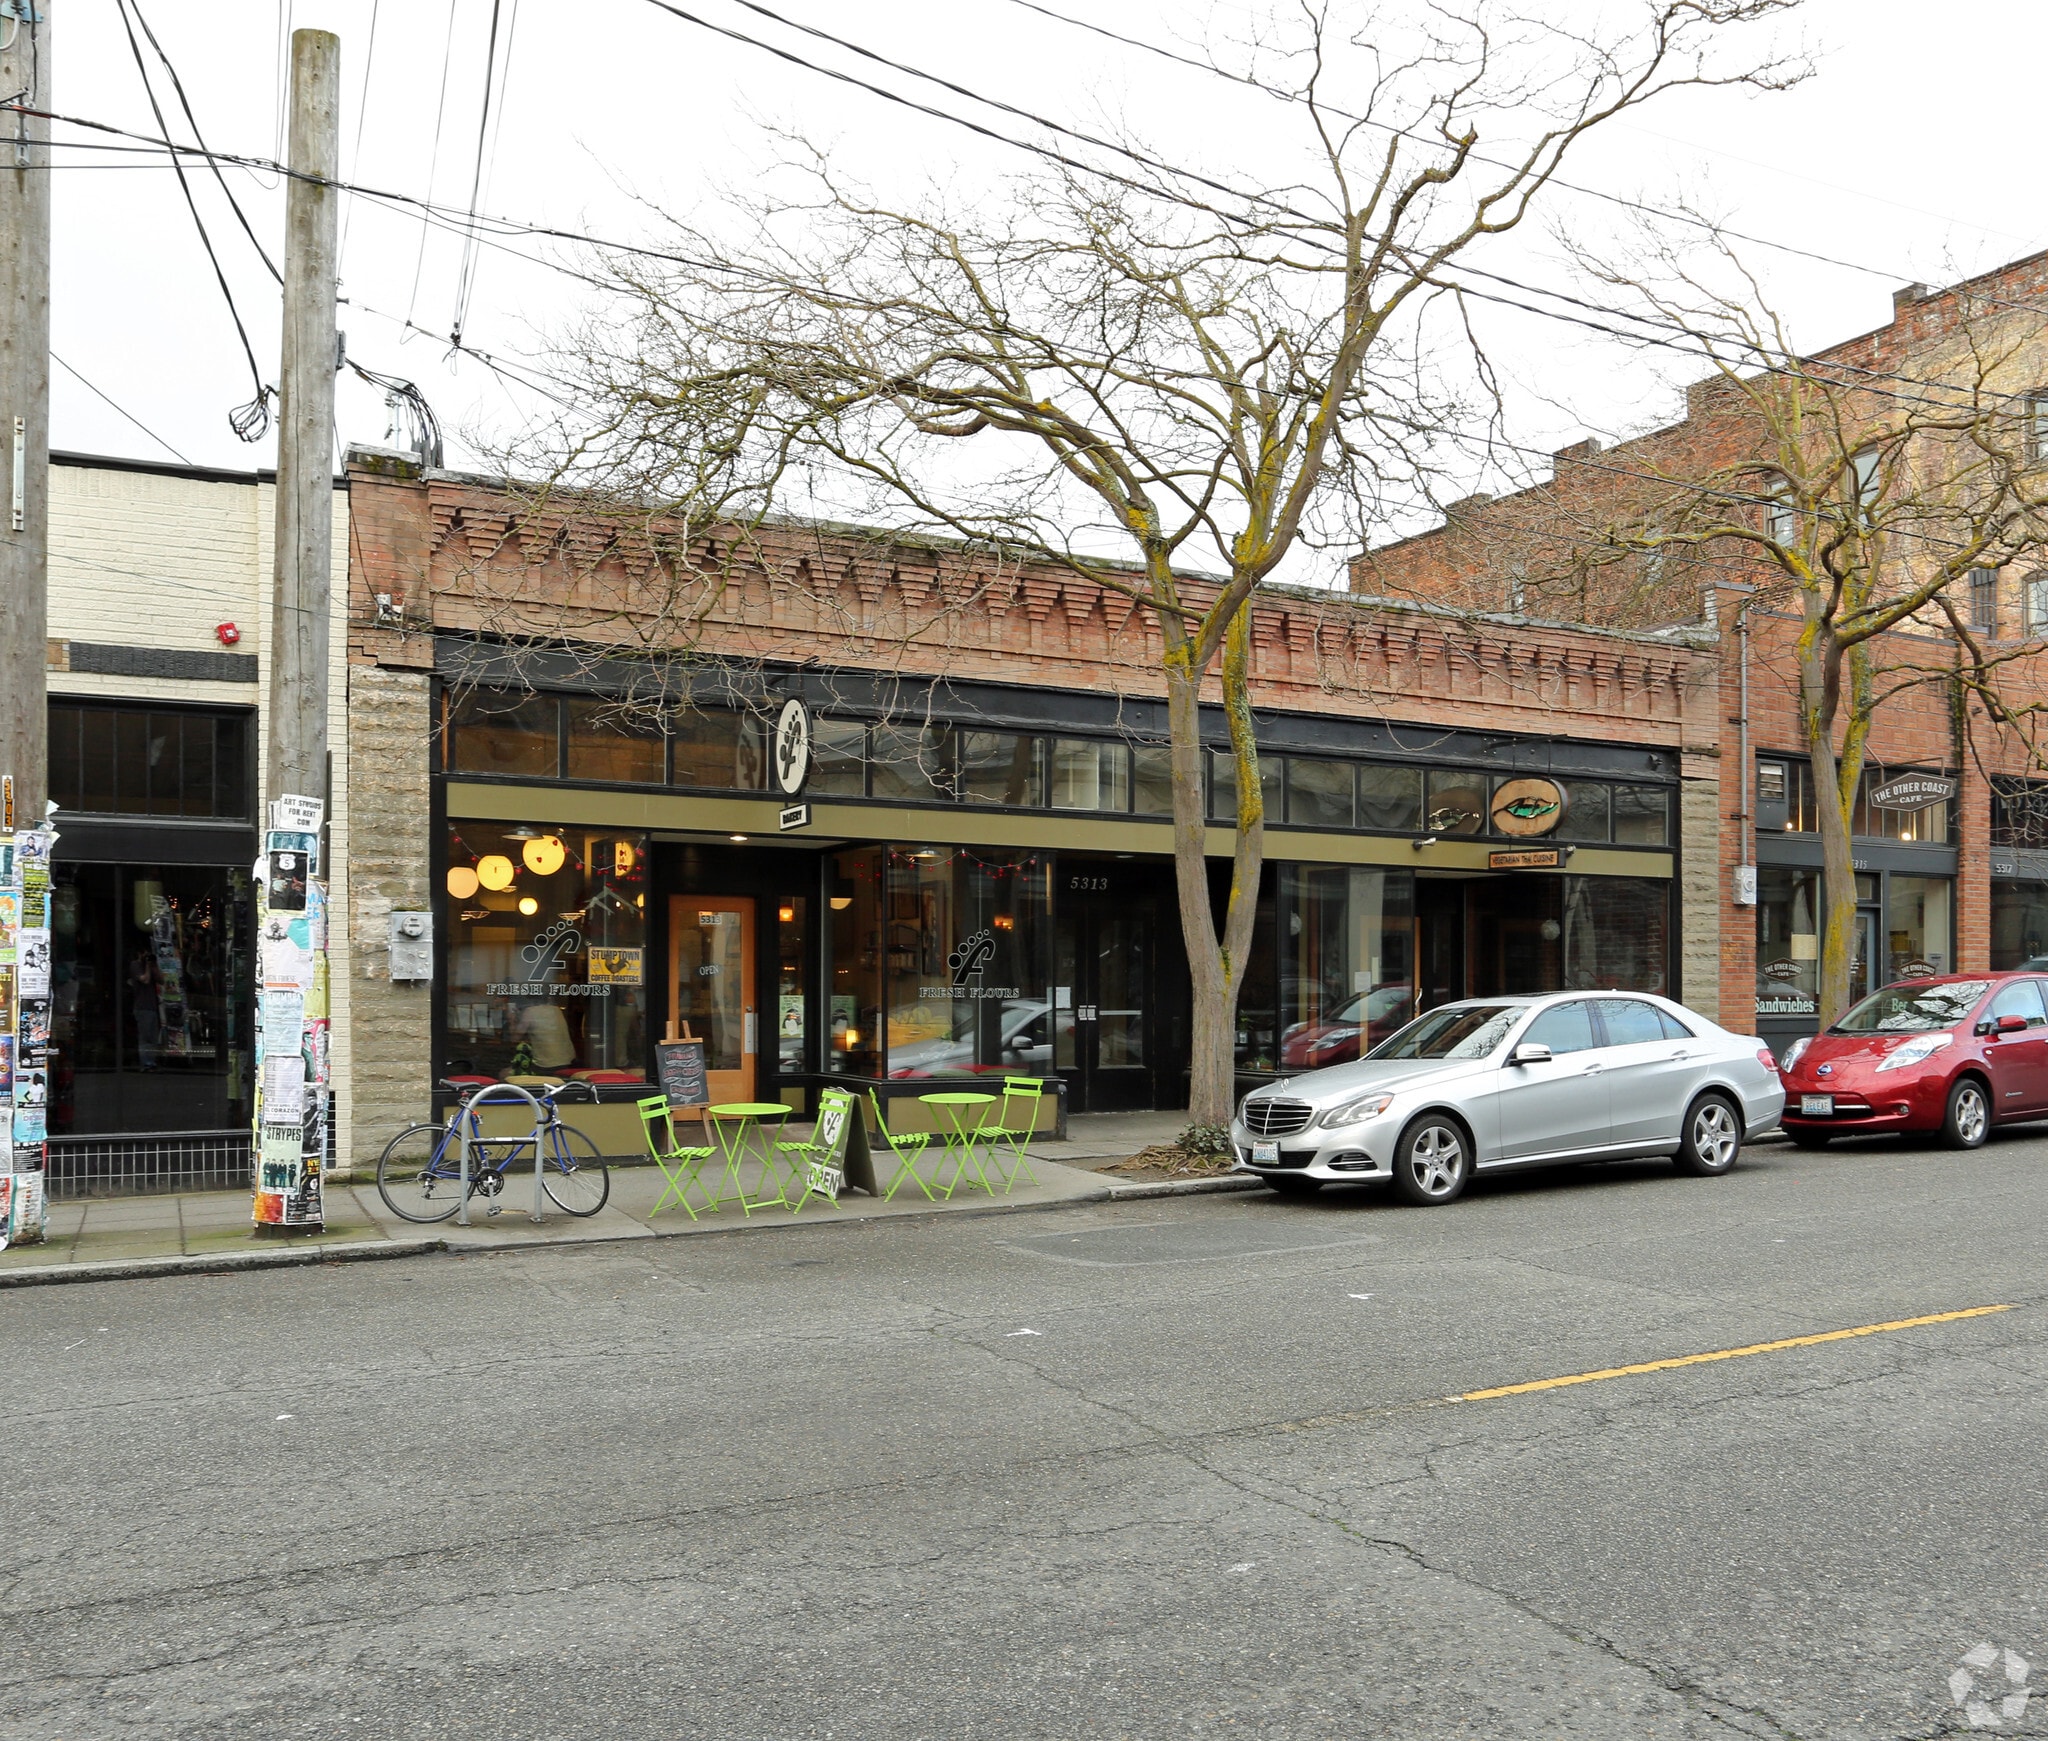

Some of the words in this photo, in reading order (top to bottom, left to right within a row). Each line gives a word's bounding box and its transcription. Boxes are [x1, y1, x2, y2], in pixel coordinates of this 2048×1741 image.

[1875, 788, 1891, 803] THE
[1893, 782, 1920, 796] OTHER
[1921, 781, 1949, 795] COAST
[283, 798, 296, 806] ART
[1899, 795, 1922, 804] CAFE
[302, 810, 316, 818] RENT
[1532, 854, 1554, 864] CUISINE
[1995, 863, 2013, 874] 5317
[1070, 876, 1108, 890] 5313
[590, 949, 640, 961] STUMPTOWN
[699, 964, 720, 976] OPEN
[1764, 964, 1774, 974] THE
[1774, 963, 1788, 971] OTHER
[1901, 965, 1910, 973] THE
[1910, 964, 1922, 972] OTHER
[590, 973, 611, 983] COFFEE
[486, 983, 543, 996] FRESH
[549, 983, 611, 997] FLOURS
[919, 986, 965, 998] FRESH
[969, 986, 1020, 999] FLOURS
[1755, 996, 1815, 1013] Sandwiches
[266, 1126, 302, 1142] STRYPES
